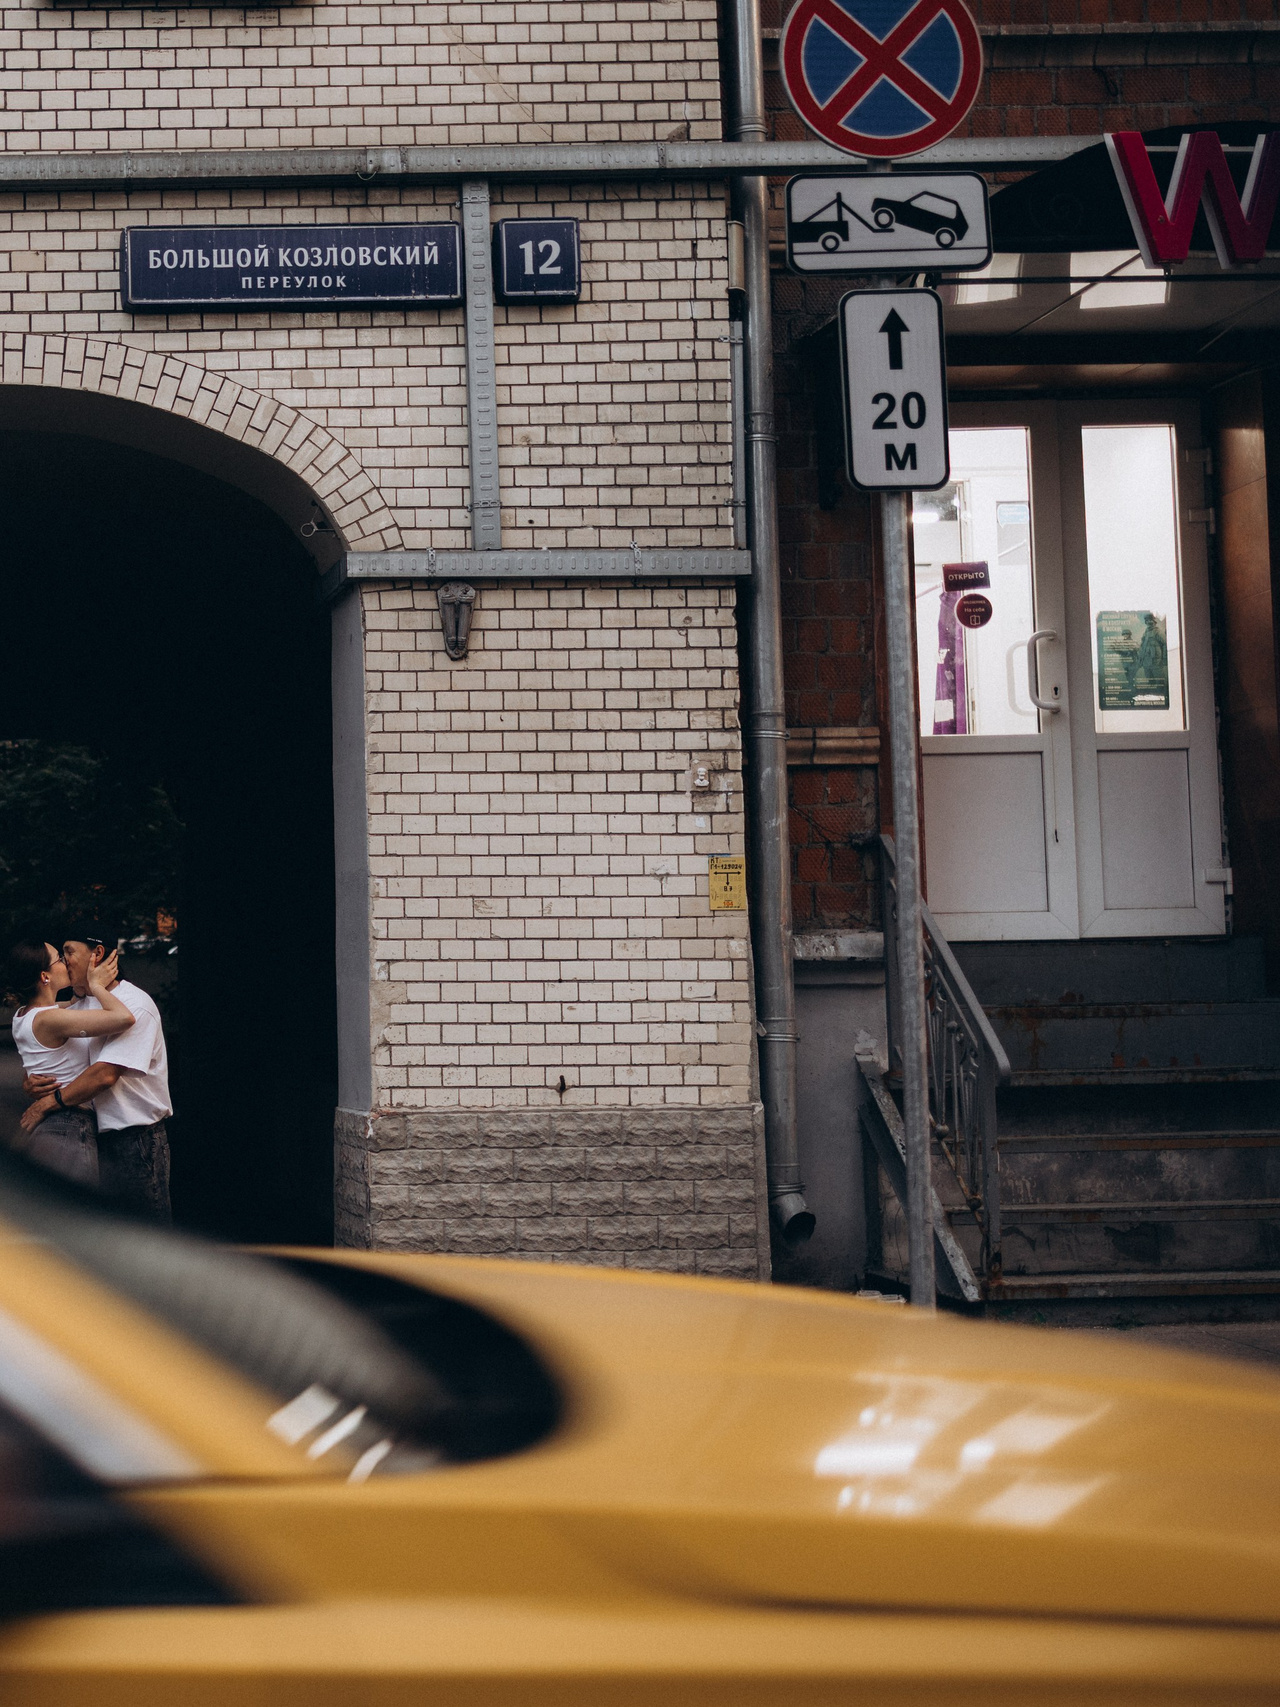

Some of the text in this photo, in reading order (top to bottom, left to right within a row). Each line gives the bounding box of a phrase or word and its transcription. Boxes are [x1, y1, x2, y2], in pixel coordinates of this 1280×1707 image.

[148, 241, 439, 270] БОЛЬШОЙ КОЗЛОВСКИЙ
[518, 239, 562, 275] 12
[241, 275, 347, 289] ПЕРЕУЛОК
[871, 391, 927, 430] 20
[884, 442, 918, 471] М
[948, 571, 986, 581] ОТКРЫТО
